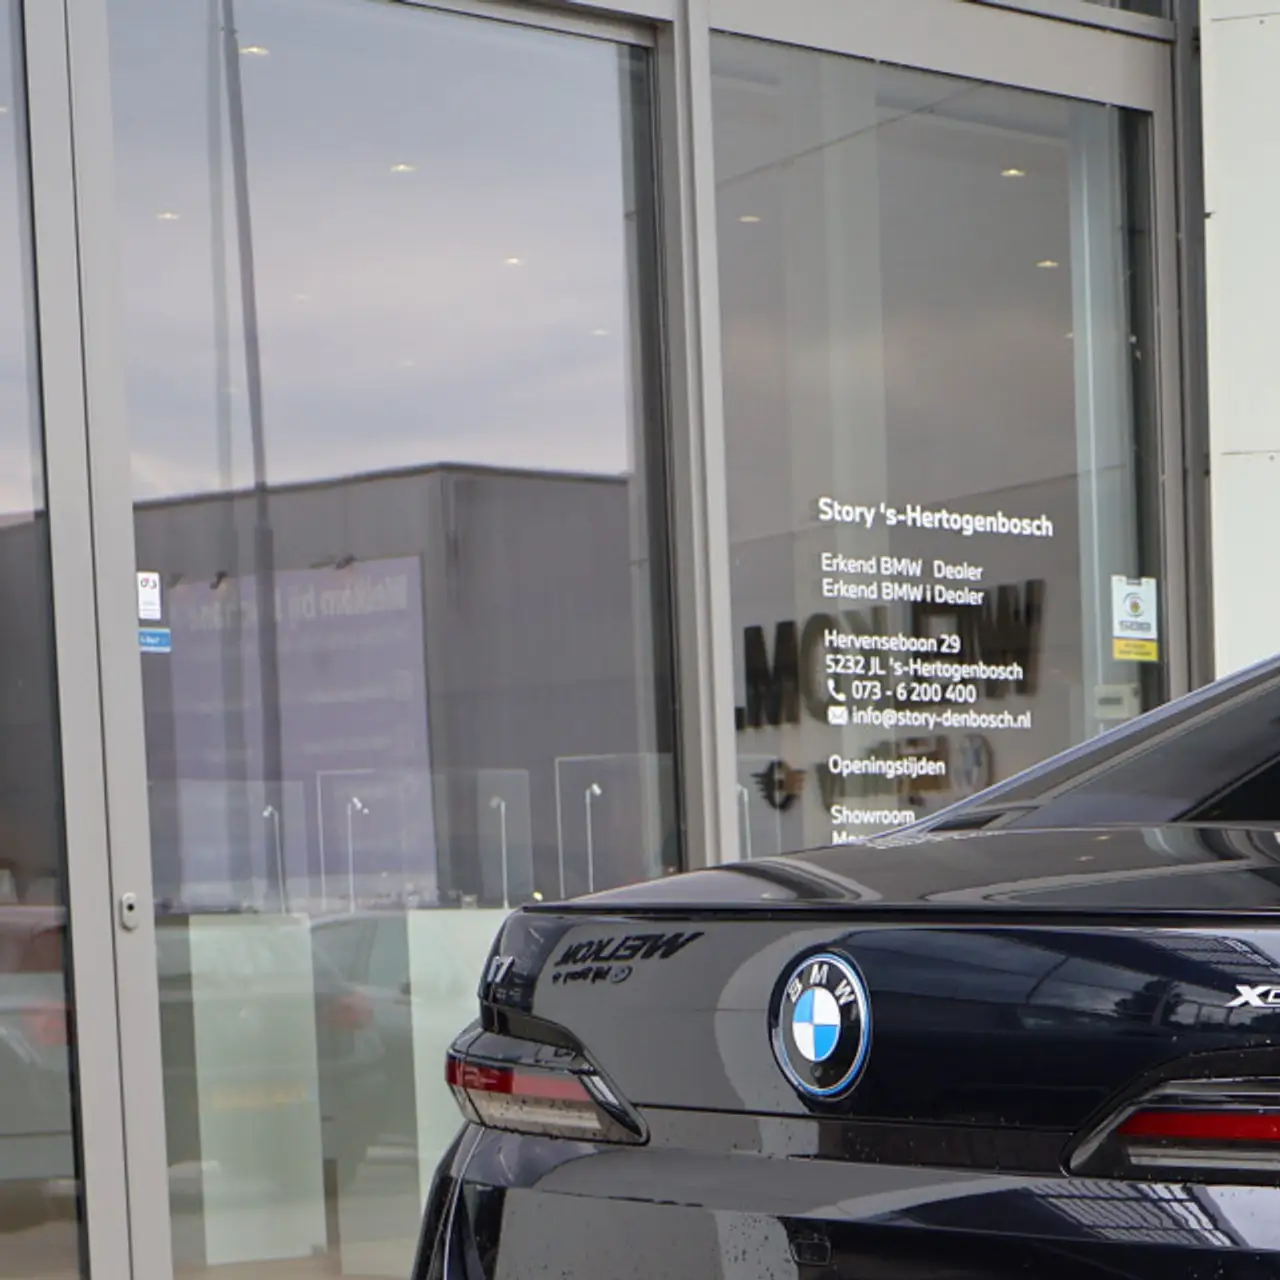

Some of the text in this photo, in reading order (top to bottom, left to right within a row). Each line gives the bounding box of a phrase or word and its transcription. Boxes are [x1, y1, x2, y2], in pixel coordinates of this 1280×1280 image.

[818, 497, 1053, 537] Story 's-Hertogenbosch
[821, 552, 983, 580] Erkend BMW Dealer
[822, 578, 985, 606] Erkend BMW i Dealer
[940, 634, 961, 654] 29
[825, 655, 1024, 682] 5232 JL 's-Hertogenbosch
[851, 680, 882, 700] 073
[896, 683, 906, 701] 6
[909, 682, 942, 703] 200
[945, 683, 977, 704] 400
[852, 706, 1032, 730] info@story-denbosch.nl
[828, 754, 946, 779] Openingstijden
[830, 804, 916, 826] Showroom
[787, 963, 856, 1007] BMW
